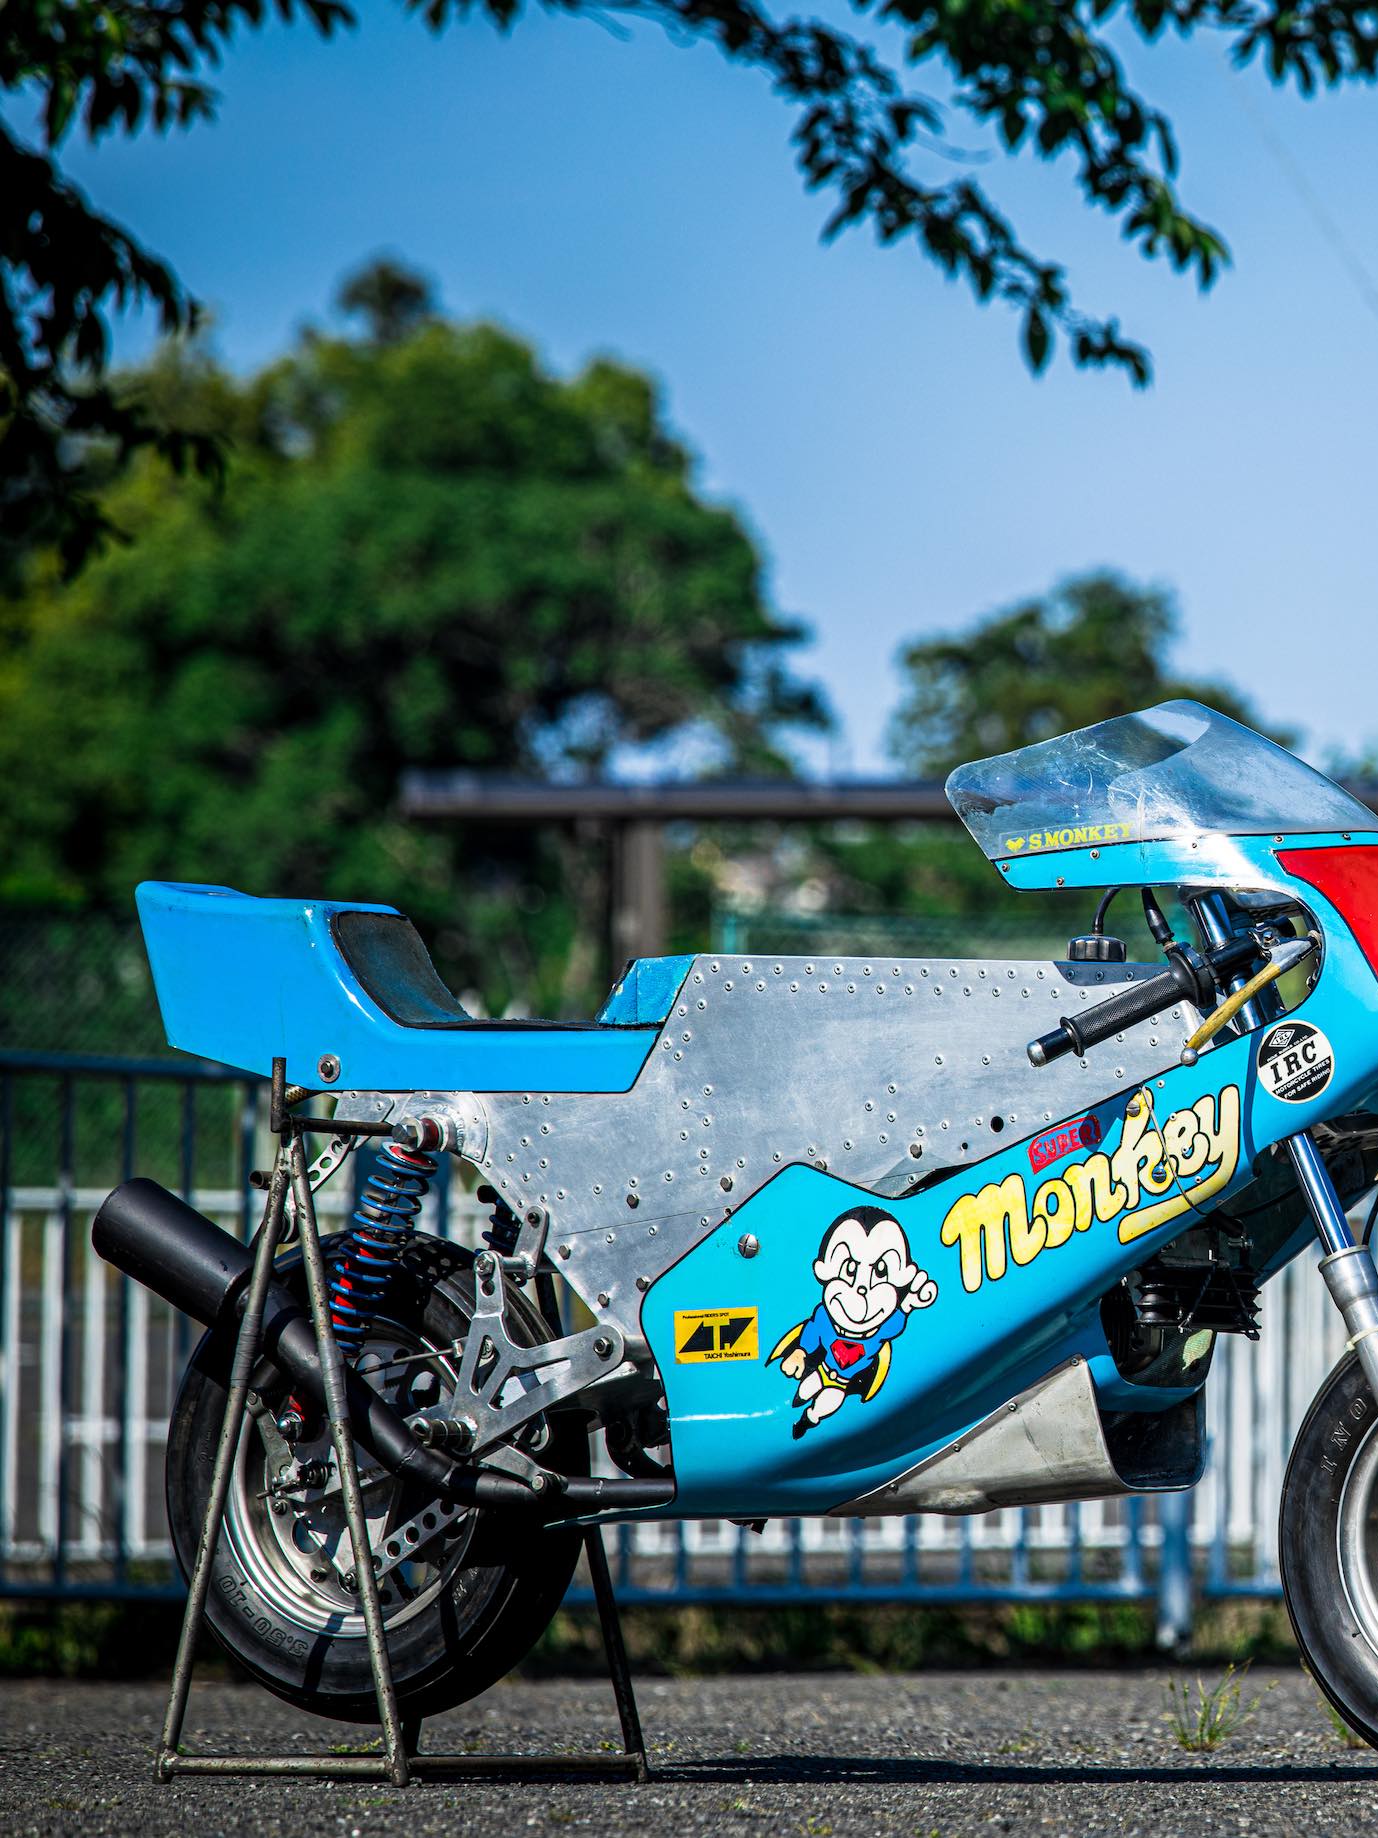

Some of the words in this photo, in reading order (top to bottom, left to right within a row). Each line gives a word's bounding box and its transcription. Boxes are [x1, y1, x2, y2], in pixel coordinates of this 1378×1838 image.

[1270, 1040, 1317, 1084] IRC
[1275, 1069, 1312, 1095] MOTORCYCLE
[1313, 1059, 1330, 1072] TIRES
[1284, 1089, 1297, 1099] FOR
[1296, 1079, 1312, 1092] SAFE
[940, 1084, 1241, 1293] Monkey
[219, 1575, 308, 1658] 3.50-10
